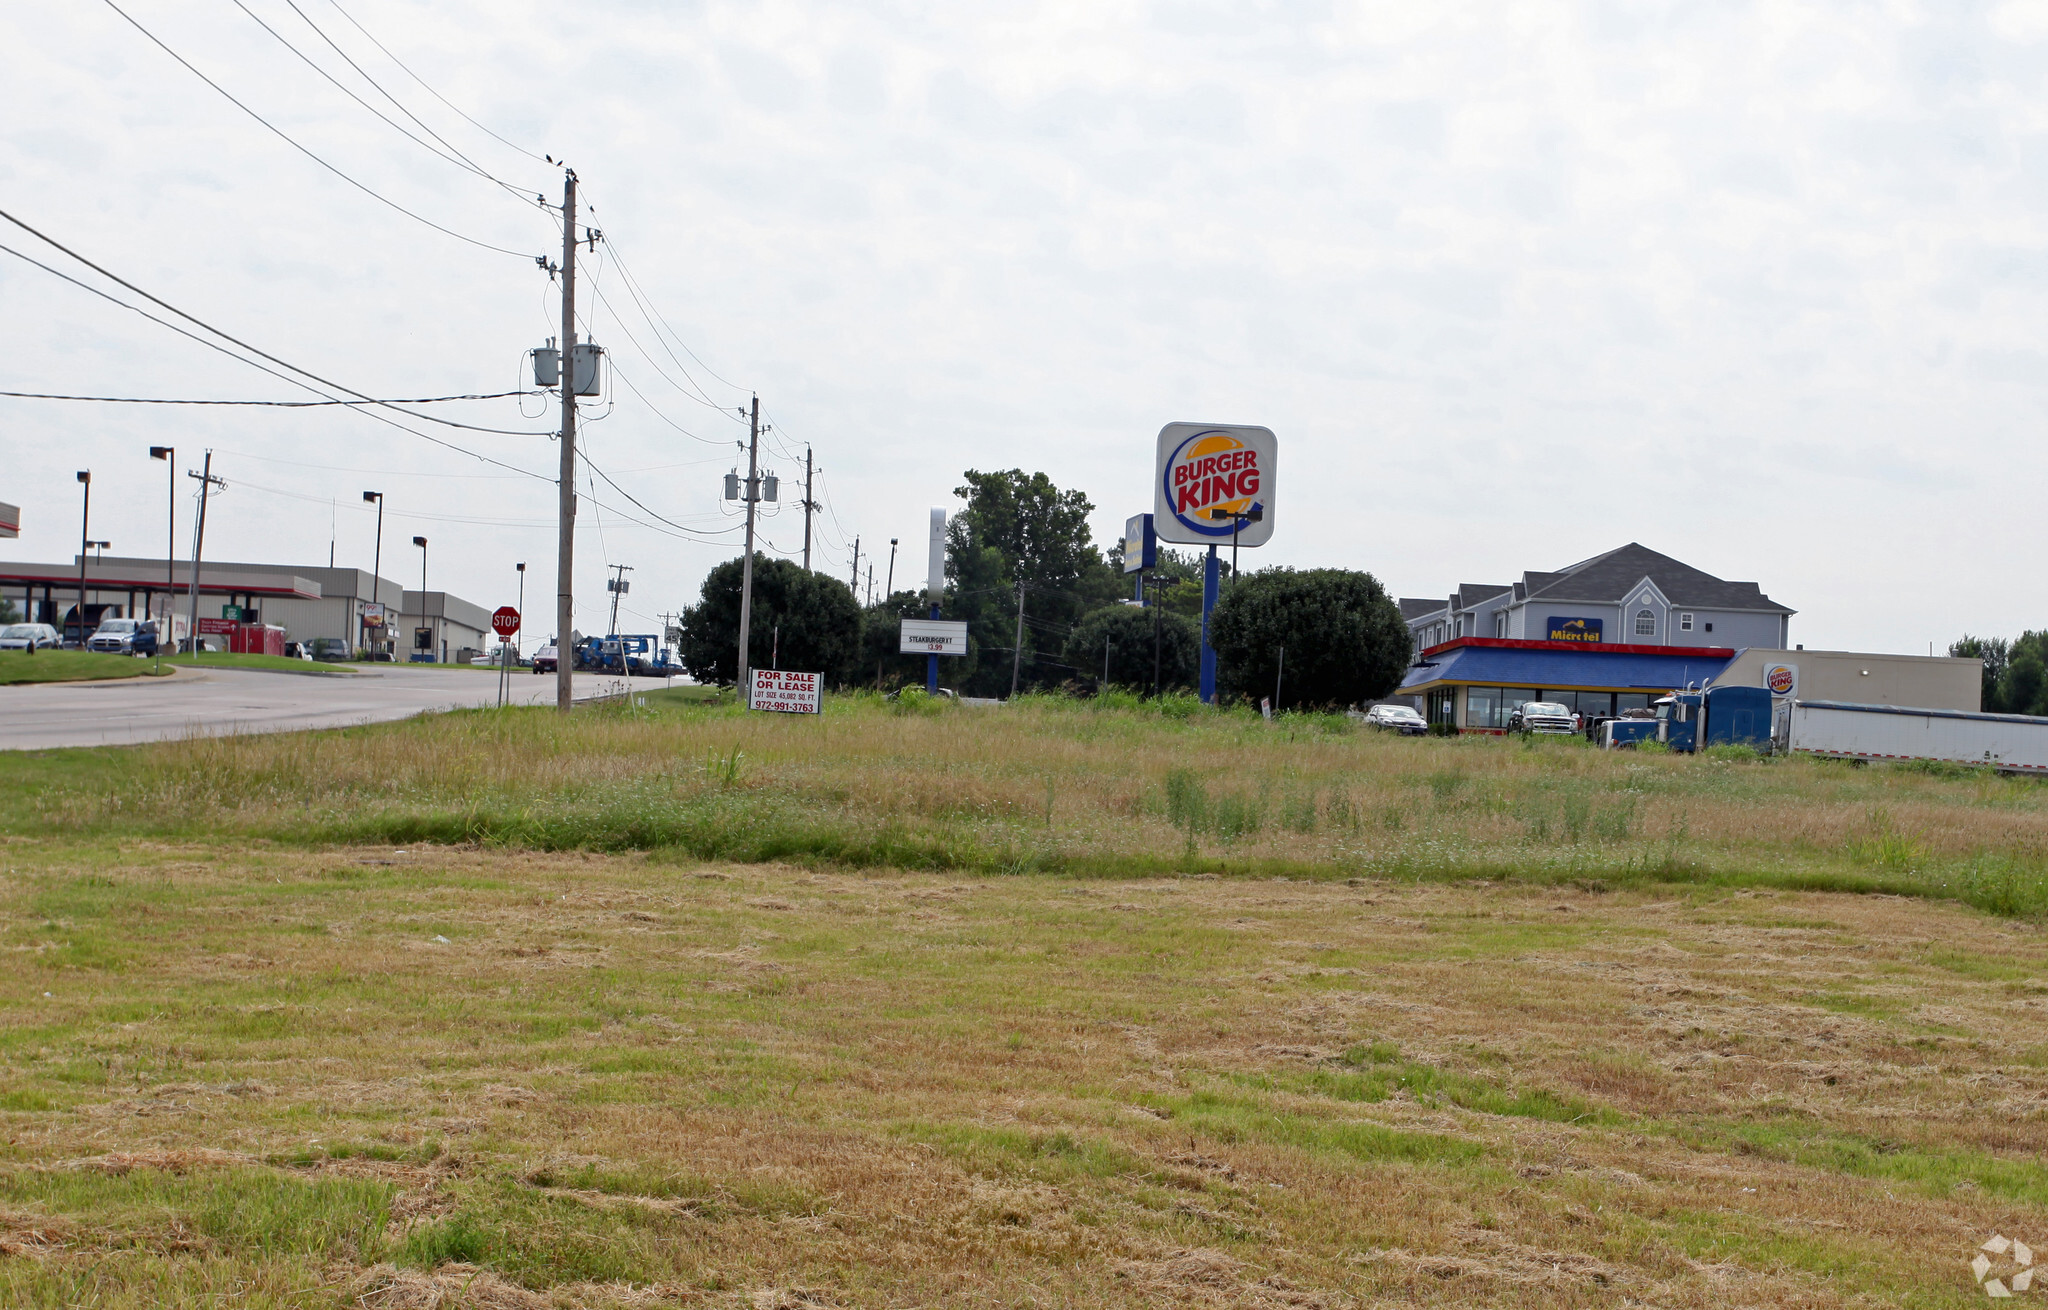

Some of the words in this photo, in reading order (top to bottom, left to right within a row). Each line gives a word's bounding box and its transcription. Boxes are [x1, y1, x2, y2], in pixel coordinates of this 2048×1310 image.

[1175, 450, 1257, 487] BURGER
[1178, 468, 1260, 514] KING
[493, 615, 519, 627] STOP
[757, 671, 781, 680] FOR
[786, 672, 815, 683] SALE
[1770, 671, 1792, 681] BURGER
[1771, 676, 1793, 688] KING
[757, 680, 773, 689] OR
[778, 682, 815, 692] LEASE
[755, 700, 814, 712] 972-991-3763
